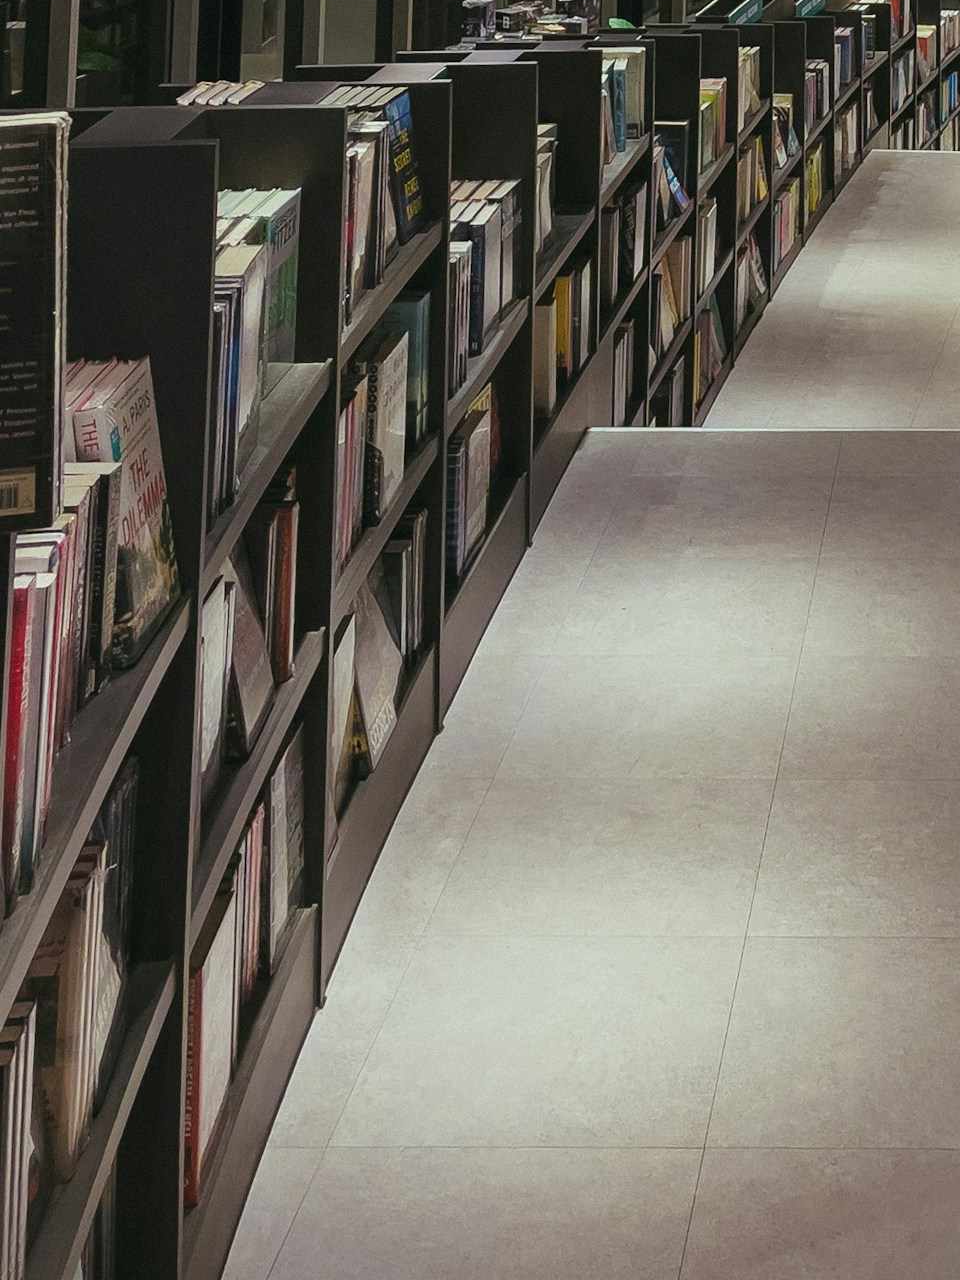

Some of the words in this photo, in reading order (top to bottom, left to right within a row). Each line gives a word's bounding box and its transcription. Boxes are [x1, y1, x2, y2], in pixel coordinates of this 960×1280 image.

[130, 390, 151, 424] PARIS
[82, 419, 99, 453] THE
[129, 448, 151, 492] THE
[122, 470, 166, 547] DILEMMA
